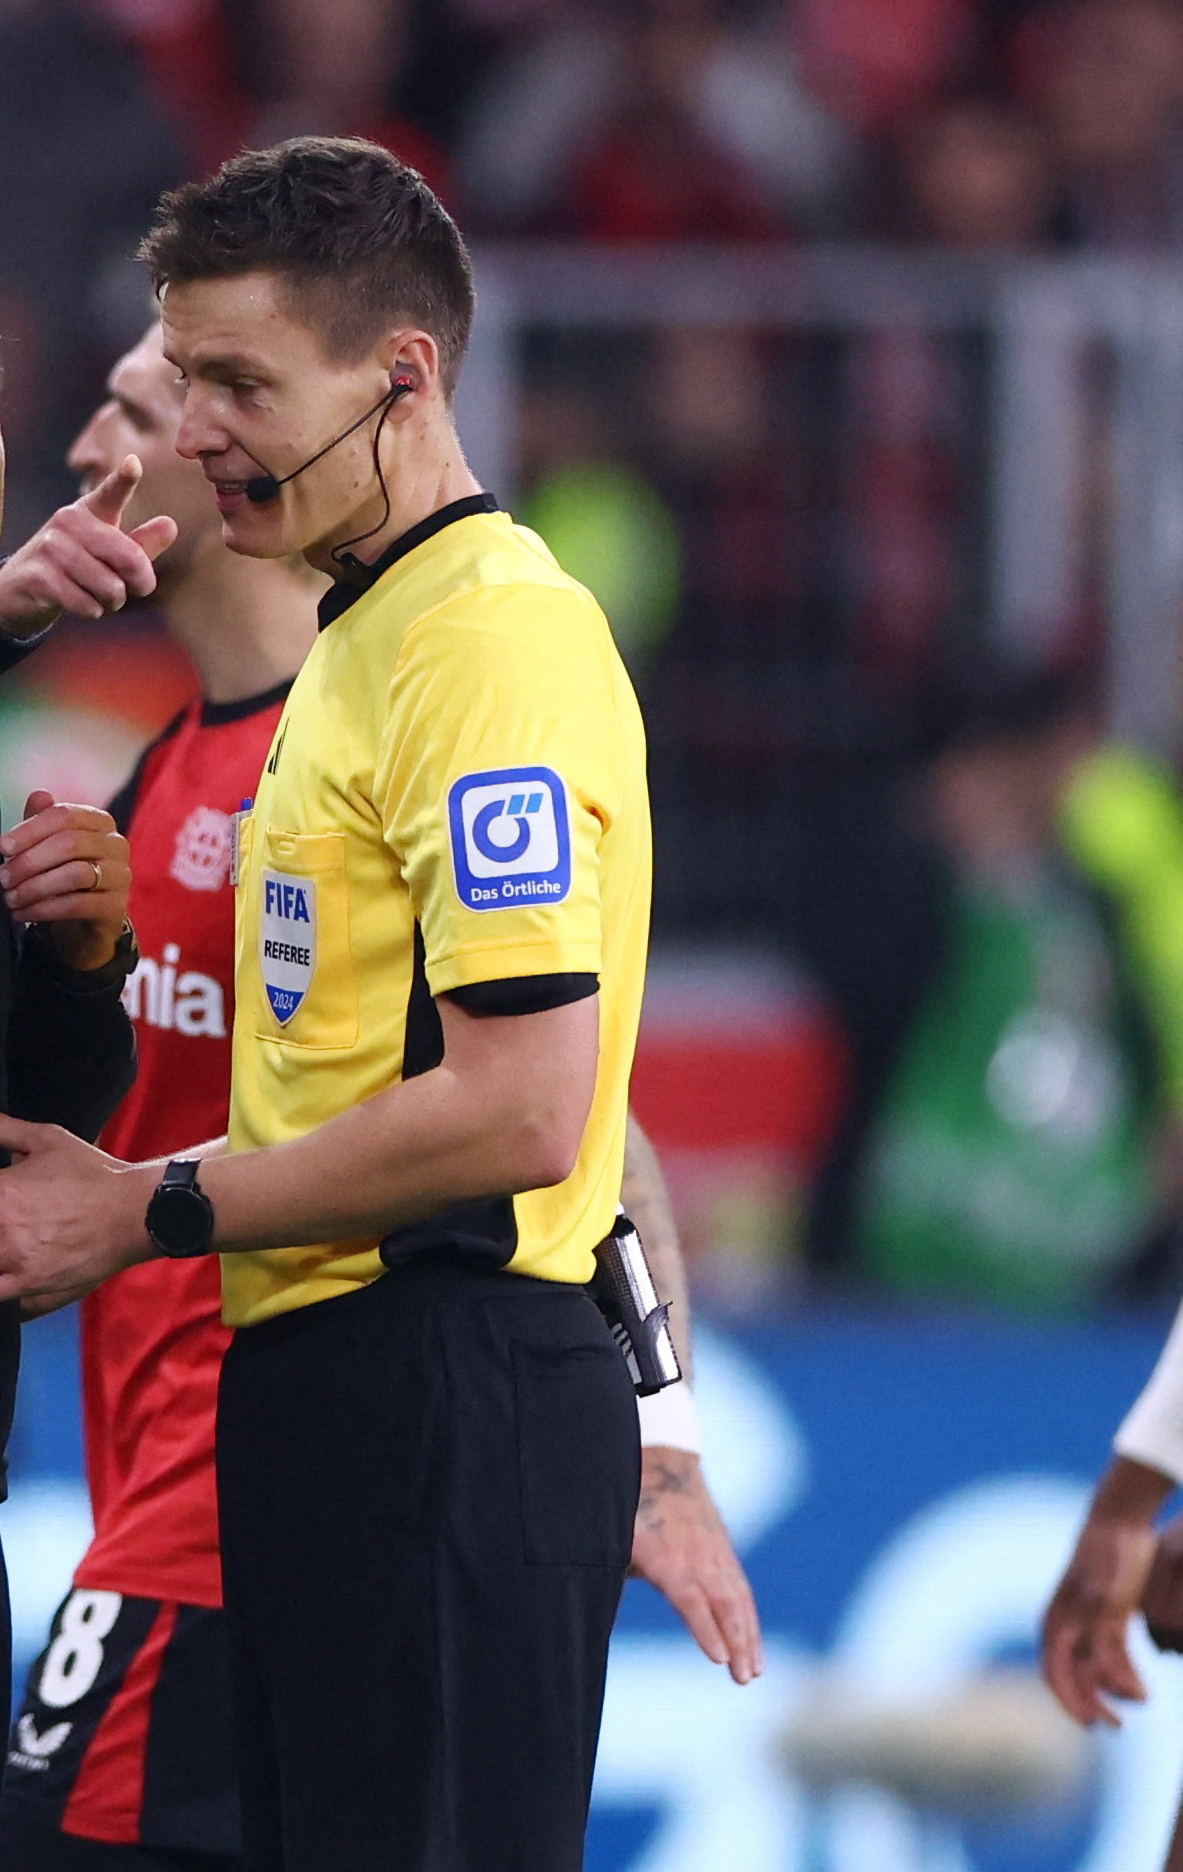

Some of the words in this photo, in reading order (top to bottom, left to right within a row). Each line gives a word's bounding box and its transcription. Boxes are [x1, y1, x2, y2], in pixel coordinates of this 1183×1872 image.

[265, 881, 310, 922] FIFA
[471, 888, 499, 902] Das
[502, 880, 561, 898] Örtliche
[264, 940, 310, 967] REFEREE
[120, 944, 226, 1036] nia
[273, 991, 294, 1011] 2024
[39, 1589, 122, 1707] 8
